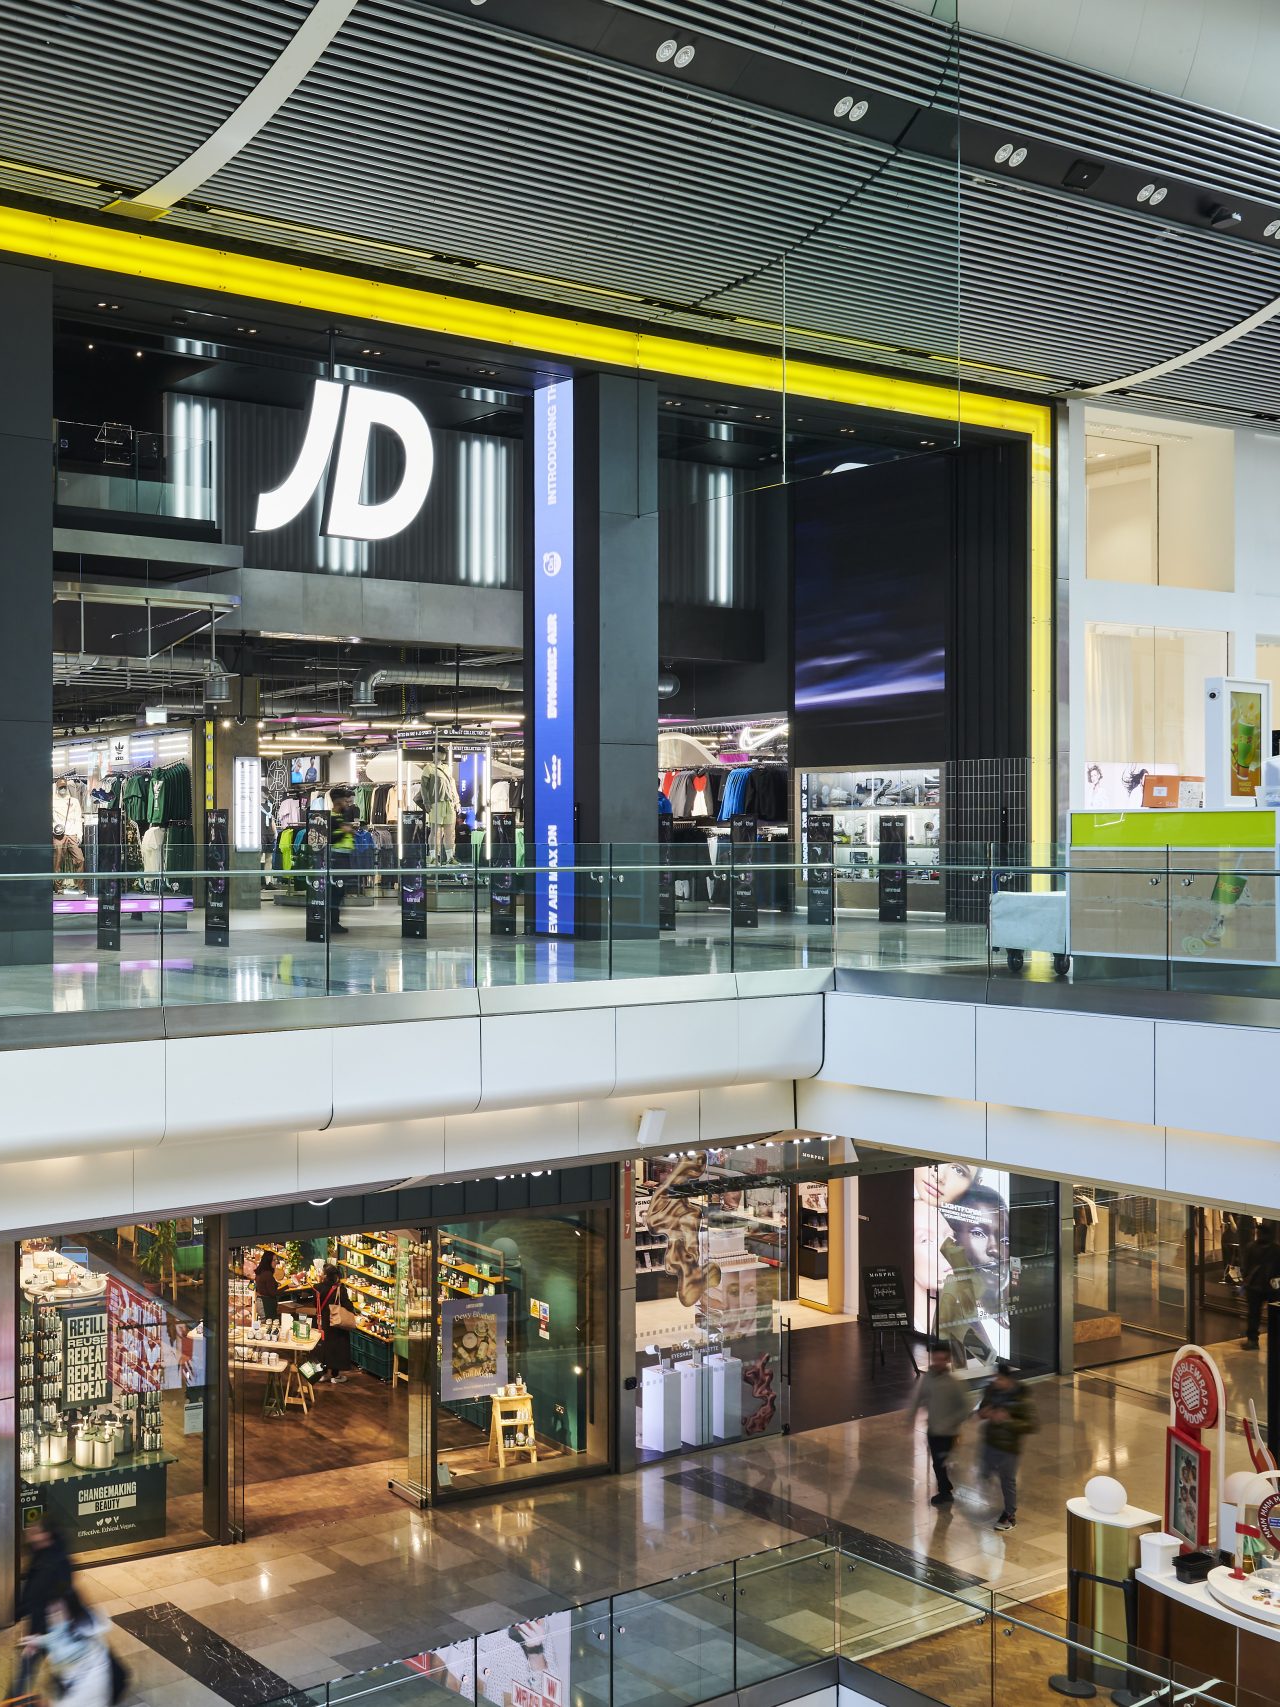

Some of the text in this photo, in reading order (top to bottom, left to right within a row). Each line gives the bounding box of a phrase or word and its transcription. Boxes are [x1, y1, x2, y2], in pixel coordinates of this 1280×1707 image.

[255, 379, 434, 540] JD
[547, 404, 557, 505] INTRODUCING
[548, 824, 558, 846] DN
[548, 884, 558, 909] AIR
[69, 1315, 106, 1337] REFILL
[67, 1335, 108, 1349] REUSE
[67, 1344, 108, 1366] REPEAT
[671, 1350, 694, 1360] EYESHAD
[67, 1361, 108, 1384] REPEAT
[66, 1380, 108, 1403] REPEAT
[1173, 1362, 1208, 1406] BUBBLEWRAP
[1176, 1399, 1205, 1424] LONDON
[78, 1481, 137, 1503] CHANGEMAKING
[95, 1498, 121, 1512] BEAUTY
[77, 1529, 102, 1538] Effective.
